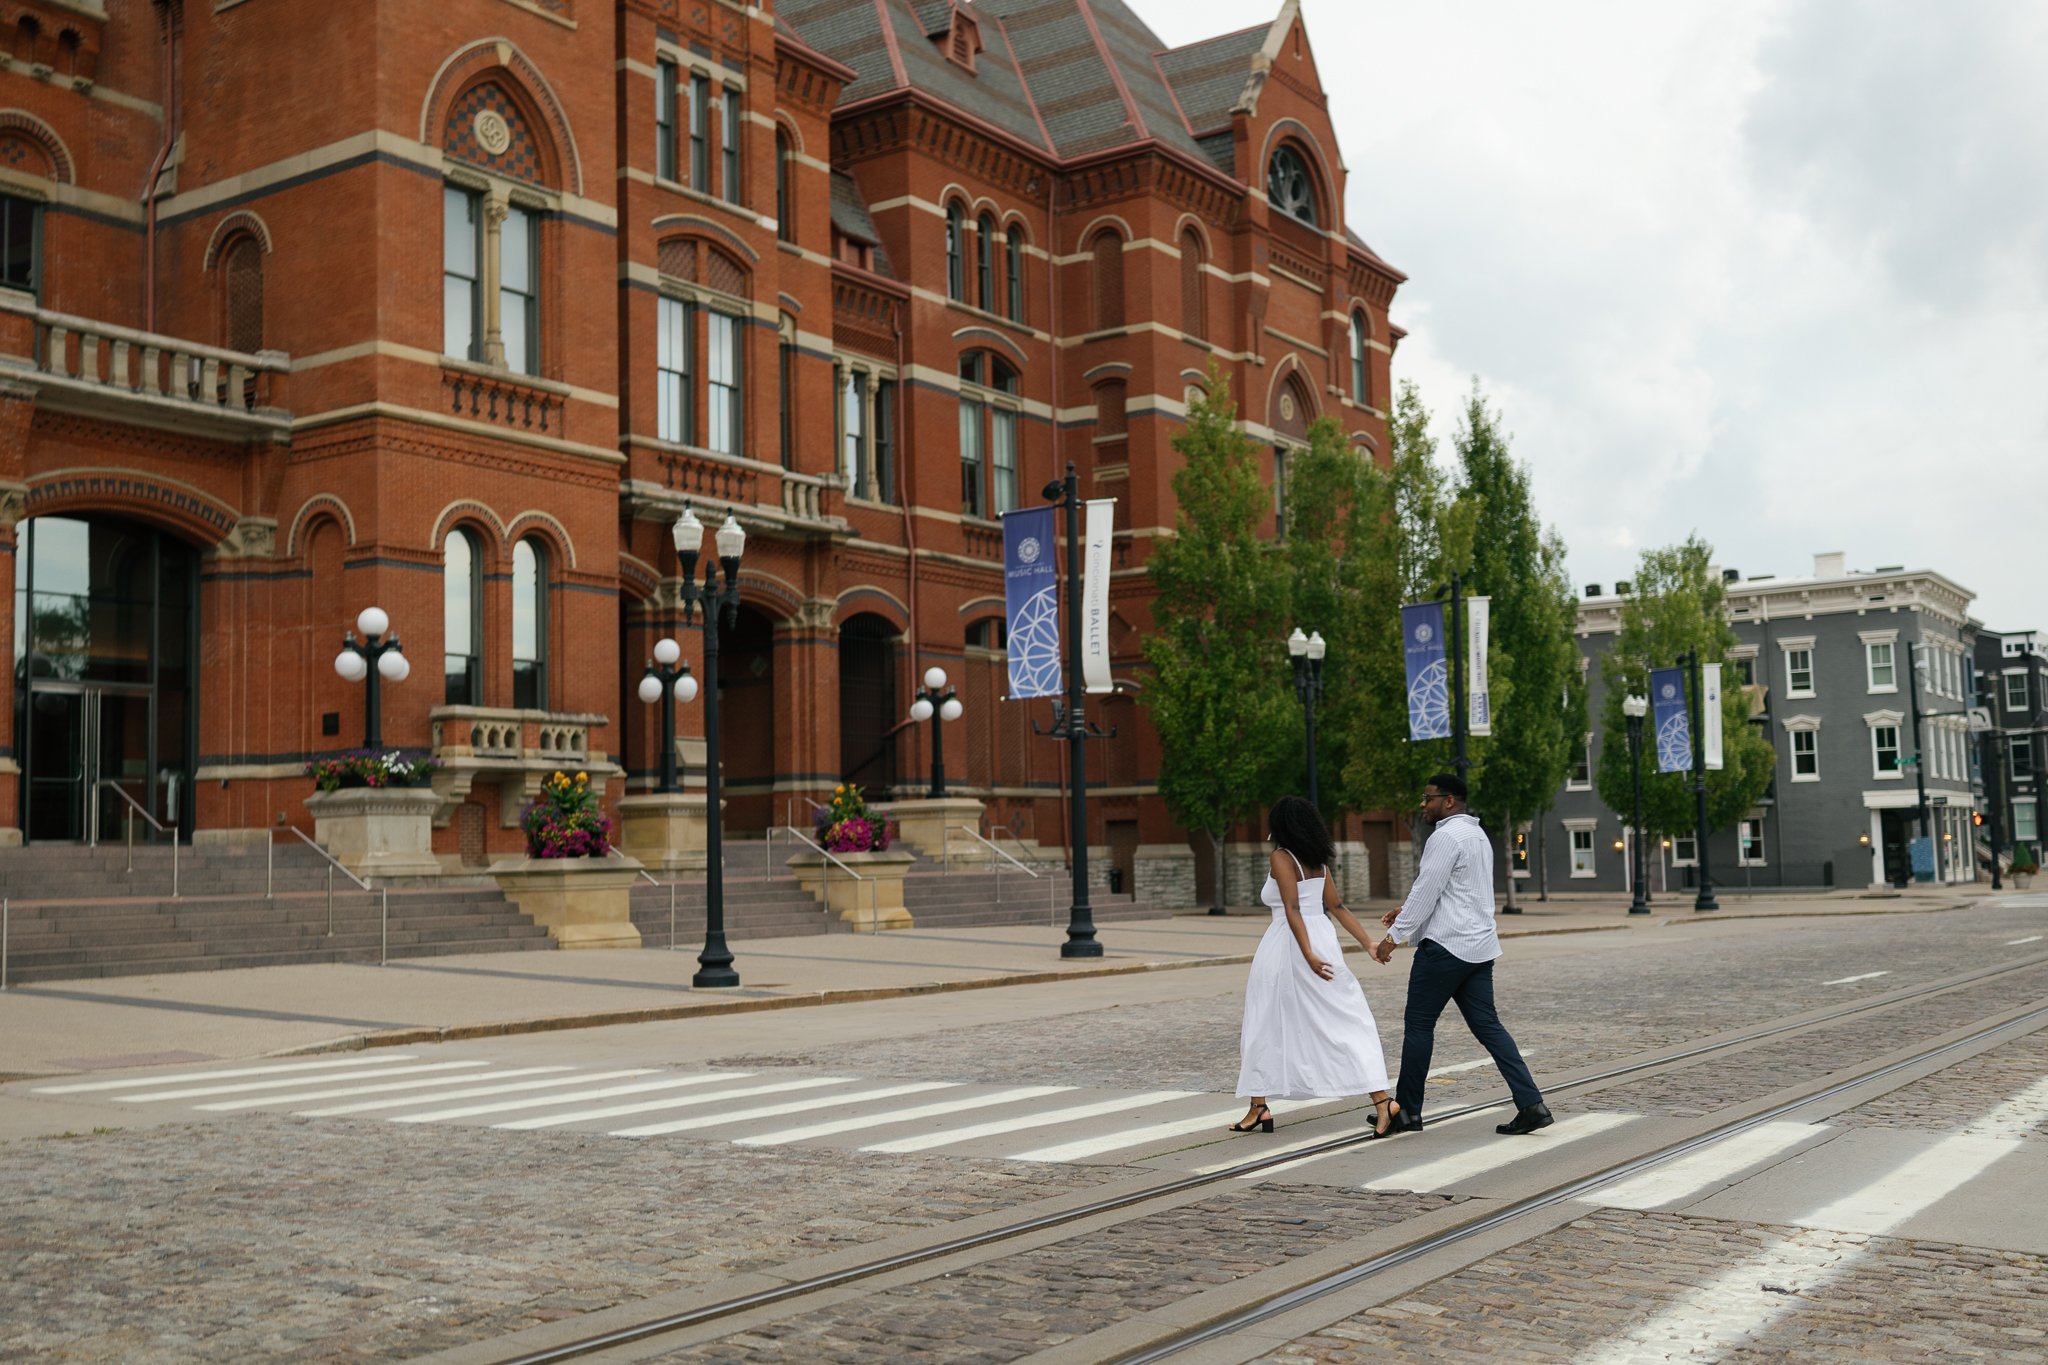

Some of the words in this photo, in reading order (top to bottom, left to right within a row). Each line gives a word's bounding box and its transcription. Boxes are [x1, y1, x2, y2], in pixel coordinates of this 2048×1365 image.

[1008, 567, 1032, 578] MUSIC
[1033, 565, 1053, 574] HALL
[1090, 608, 1100, 656] BALLET
